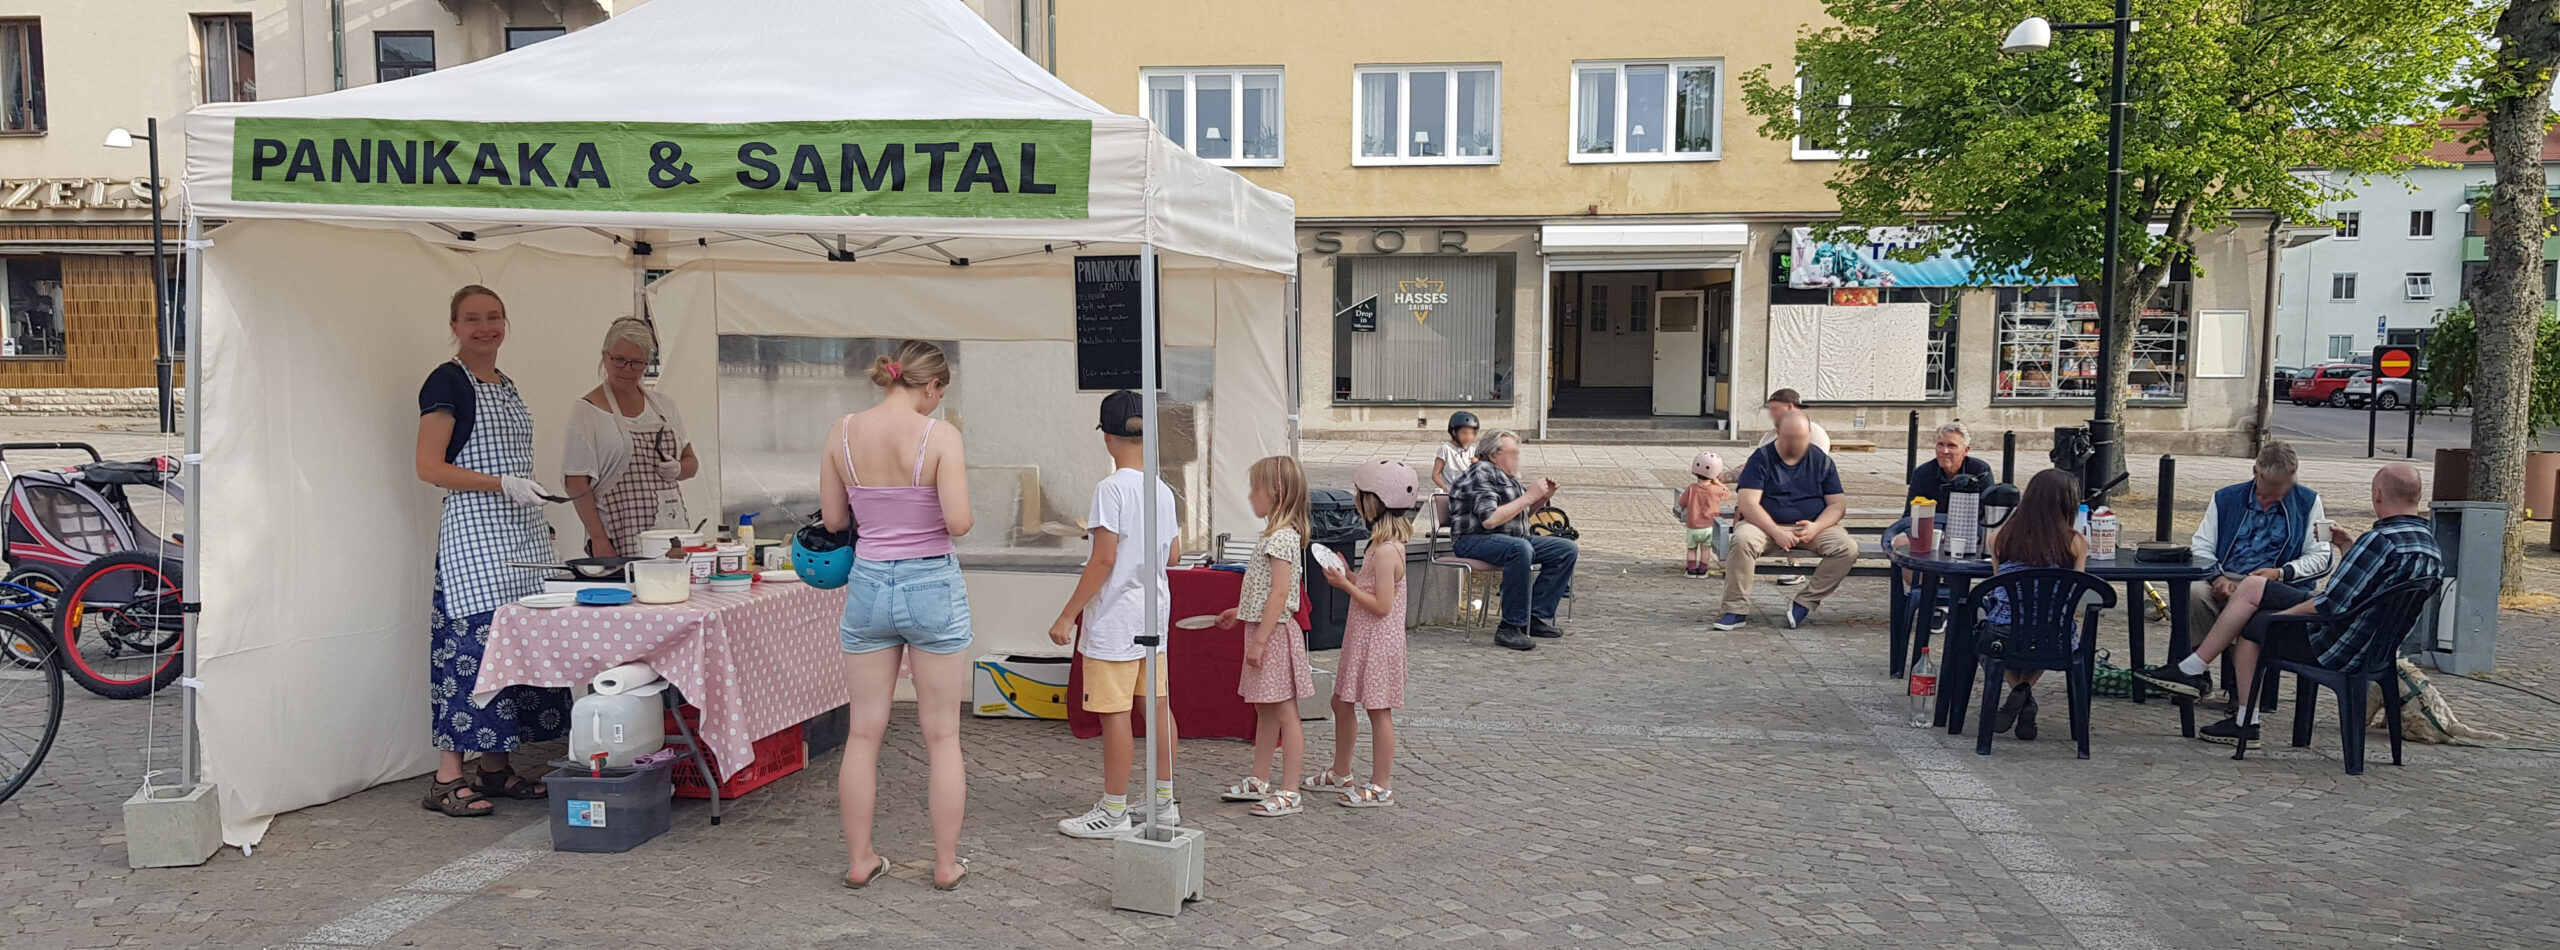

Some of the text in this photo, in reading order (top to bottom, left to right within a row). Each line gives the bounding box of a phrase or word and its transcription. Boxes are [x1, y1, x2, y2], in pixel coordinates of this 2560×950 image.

[251, 138, 1057, 194] PANNKAKA & SAMTAL
[0, 177, 169, 210] ZELS
[1314, 227, 1468, 254] SÖR
[1077, 259, 1141, 283] PANNKAKO
[1099, 282, 1124, 291] GRATIS
[1394, 292, 1449, 304] HASSES
[1355, 309, 1374, 319] Drop
